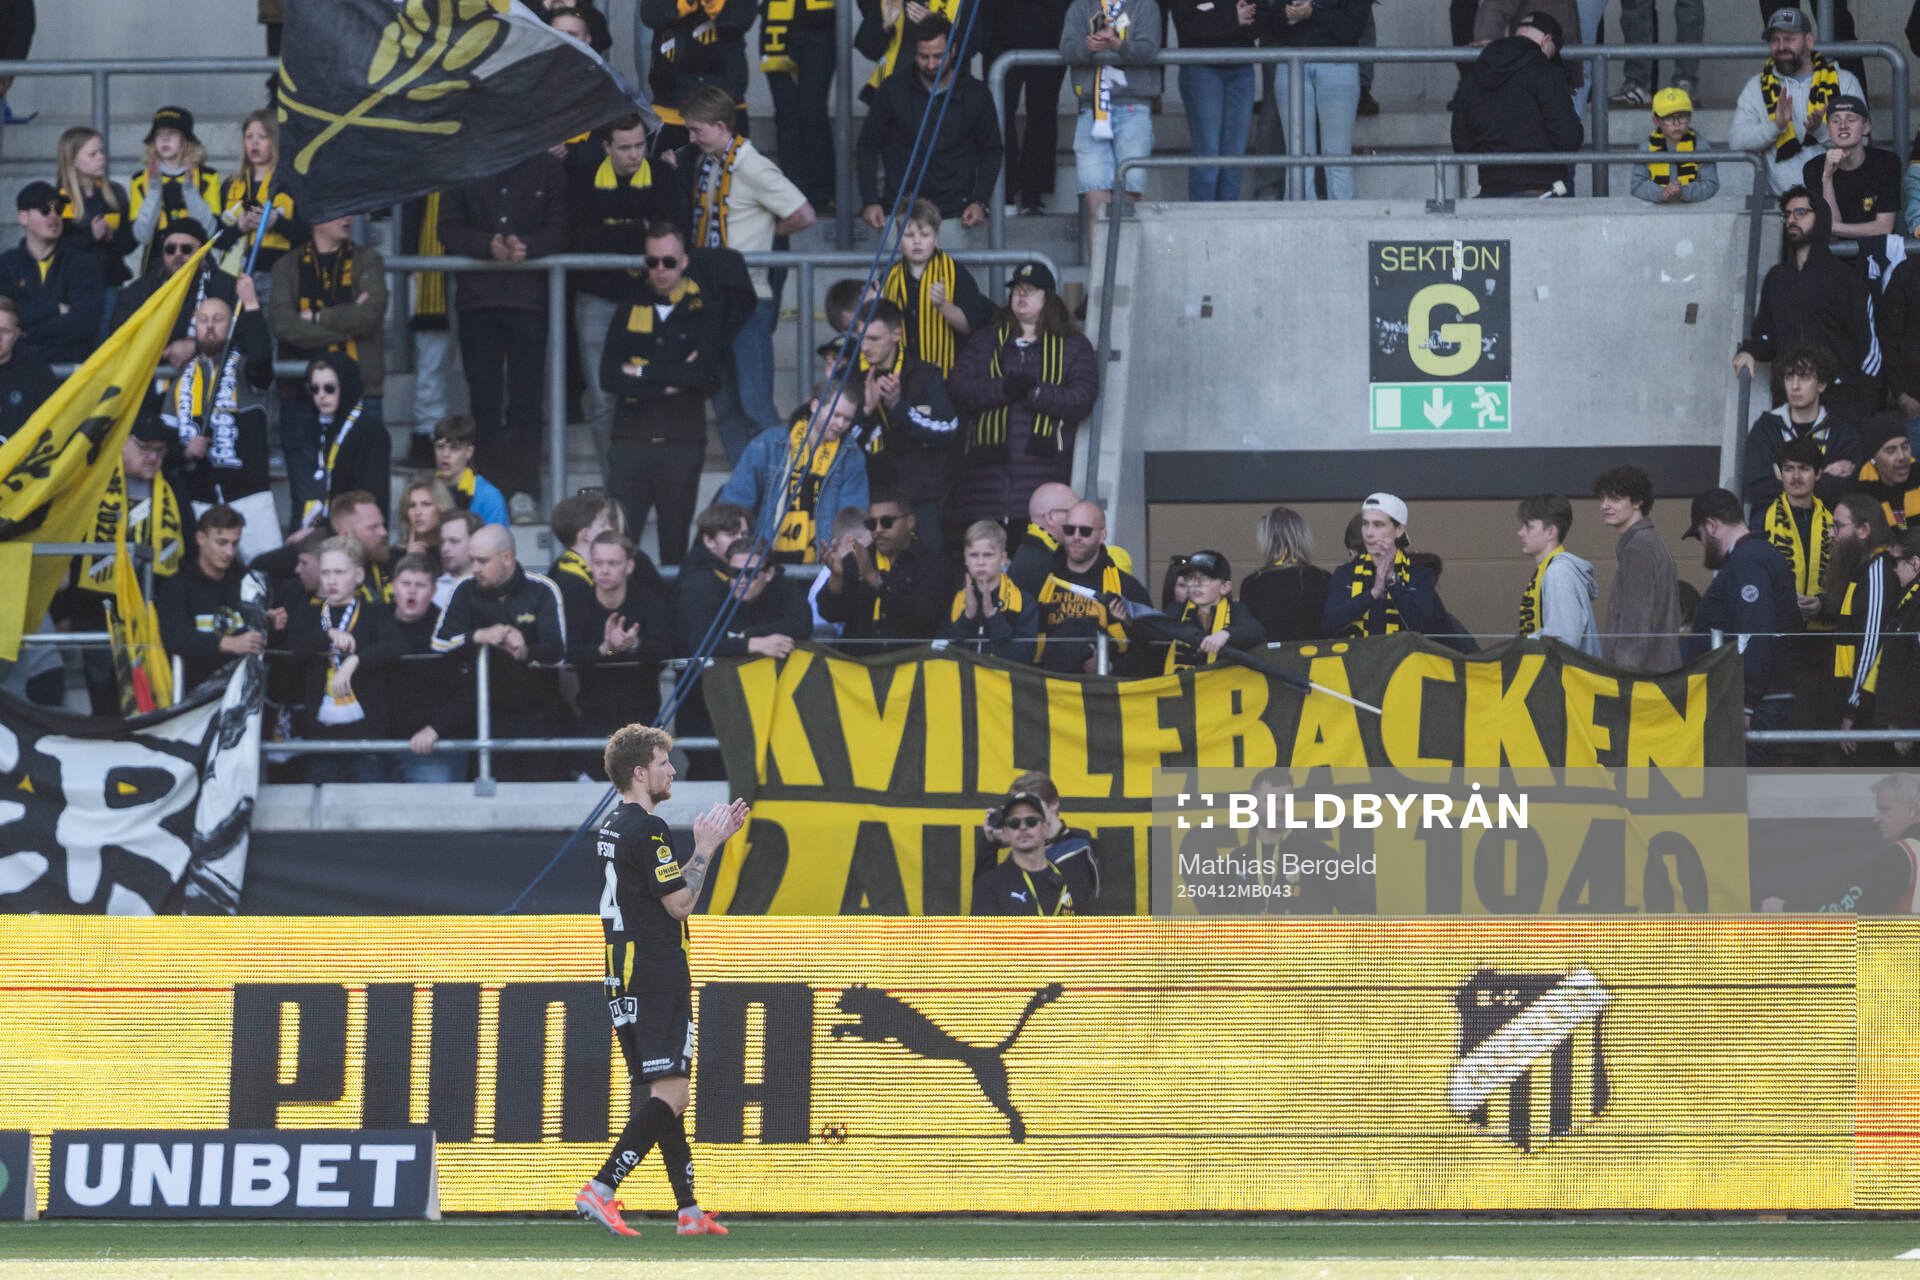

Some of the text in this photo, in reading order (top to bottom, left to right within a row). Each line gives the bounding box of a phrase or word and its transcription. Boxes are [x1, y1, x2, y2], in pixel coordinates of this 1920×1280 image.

[1407, 283, 1482, 377] G
[738, 642, 1708, 799] KVILLEBÄCKEN
[228, 983, 813, 1143] PUMA
[64, 1143, 416, 1207] UNIBET
